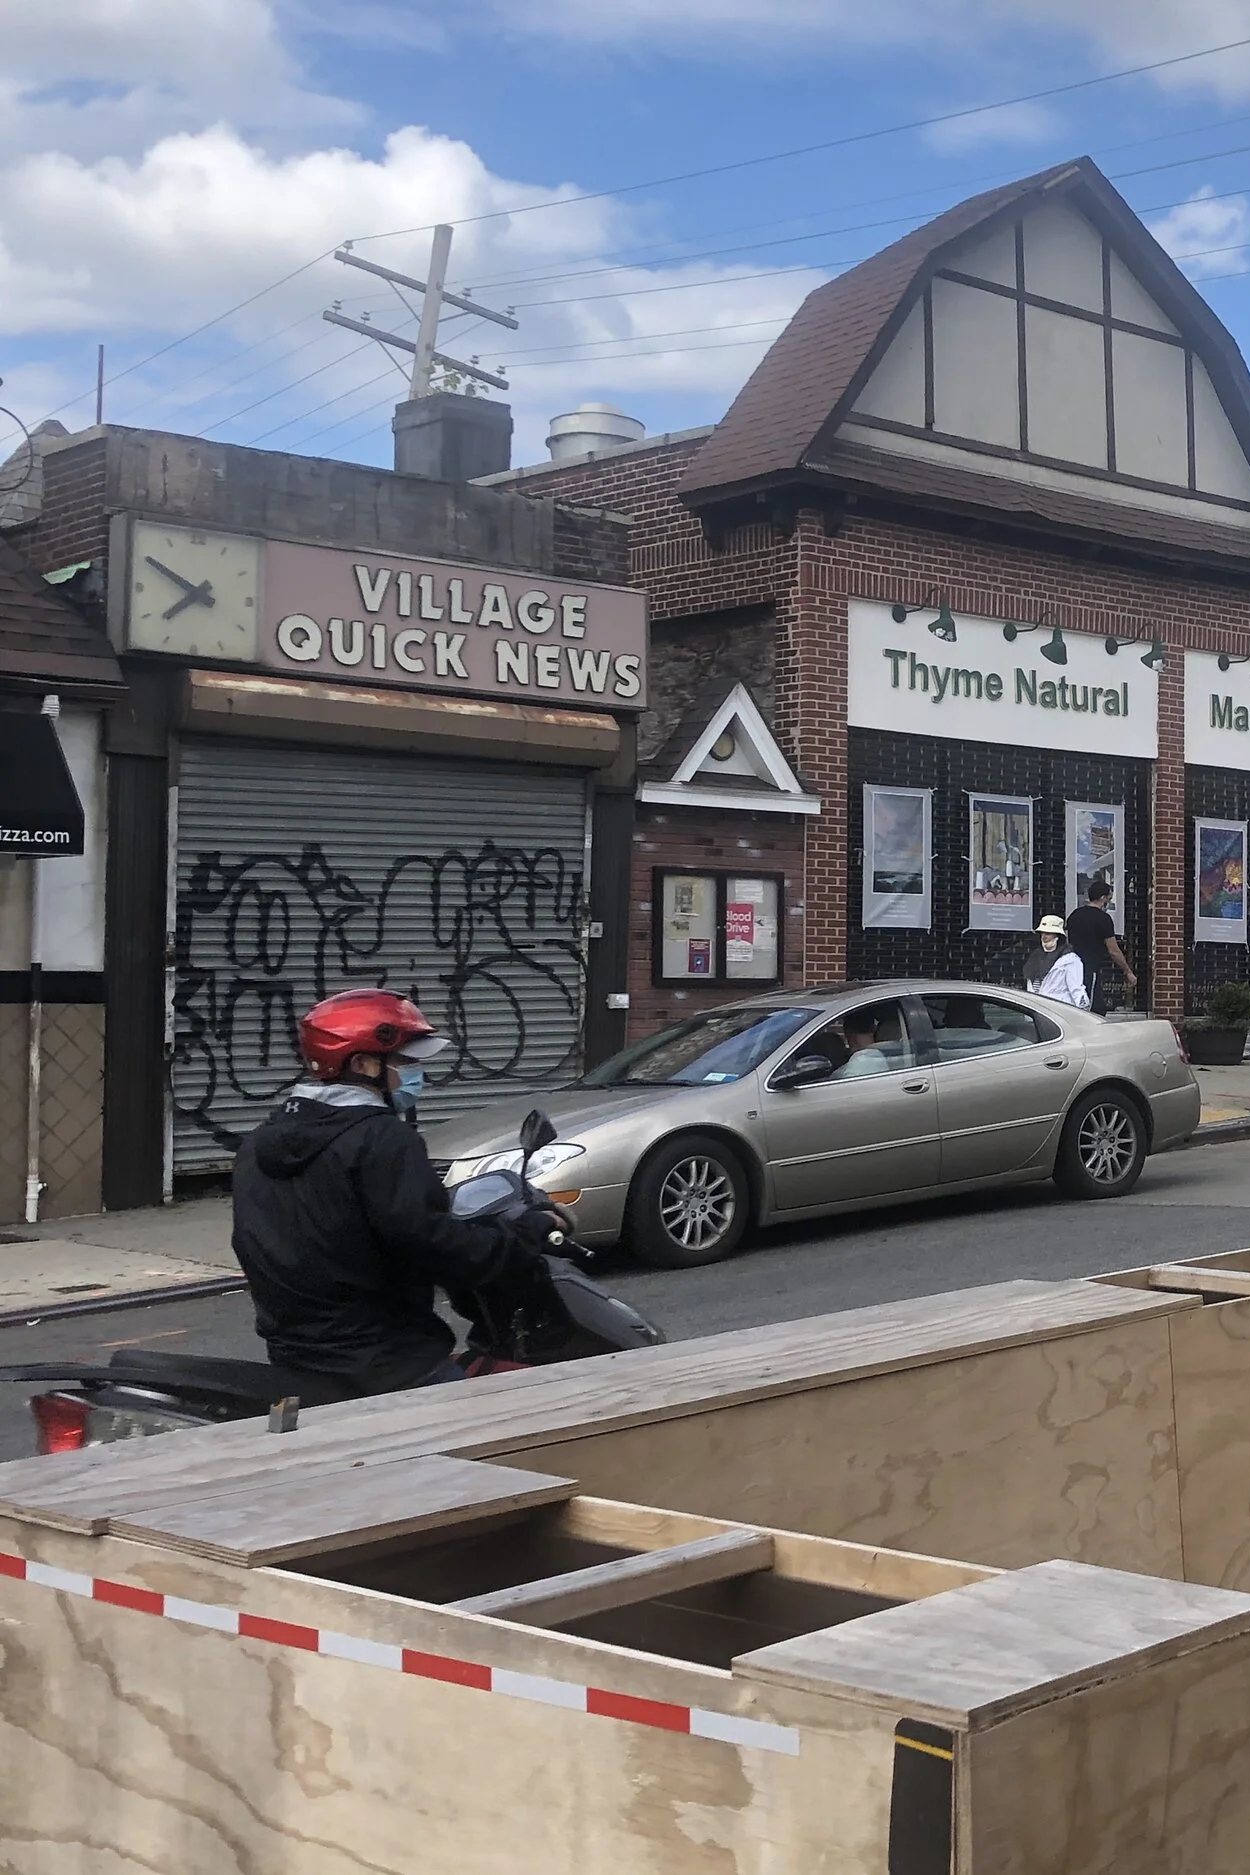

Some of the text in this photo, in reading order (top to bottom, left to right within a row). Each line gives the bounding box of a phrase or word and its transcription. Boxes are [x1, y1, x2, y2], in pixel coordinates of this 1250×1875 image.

[353, 563, 588, 639] VILLAGE
[276, 613, 642, 698] QUICK NEWS
[882, 648, 1129, 717] Thyme Natural
